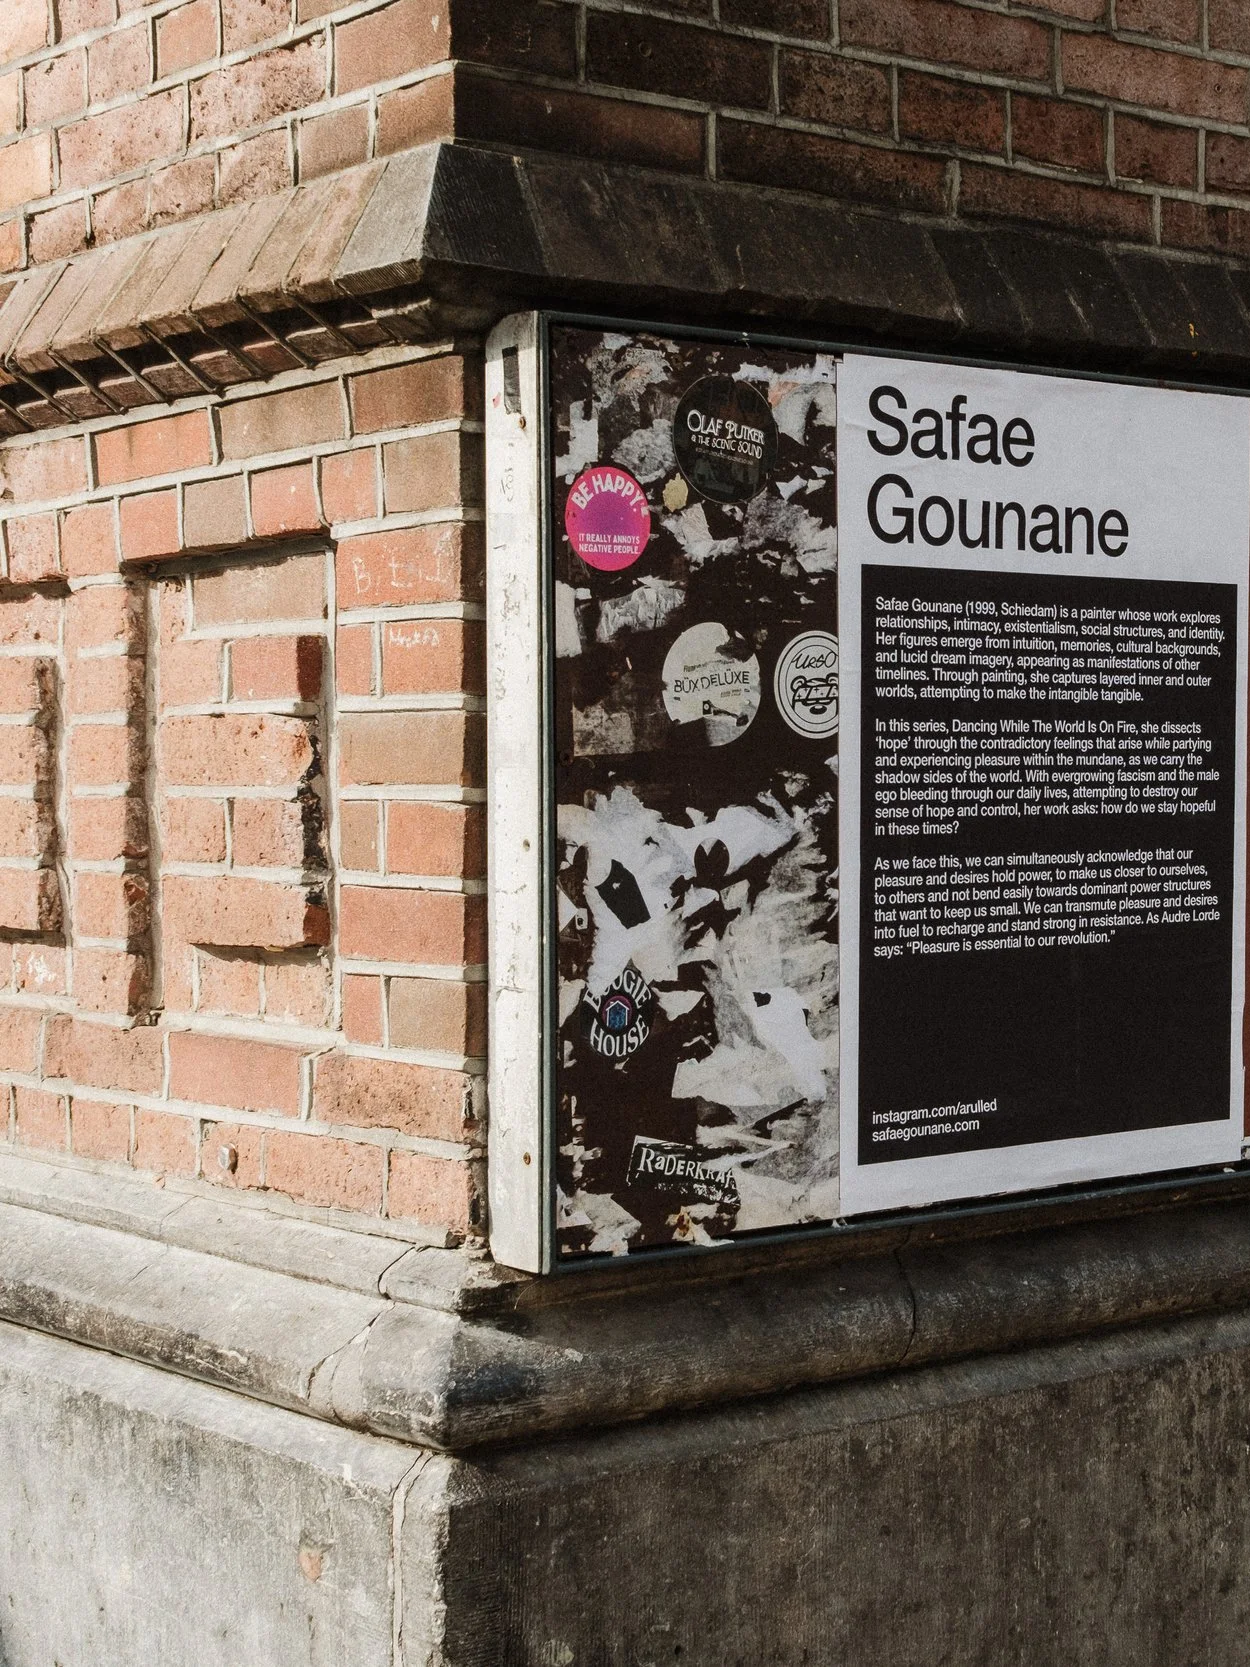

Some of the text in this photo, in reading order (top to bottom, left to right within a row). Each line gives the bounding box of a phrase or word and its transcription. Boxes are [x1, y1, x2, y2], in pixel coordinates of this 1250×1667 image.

[686, 409, 723, 436] OLAF
[866, 385, 1036, 467] Safae
[698, 435, 711, 447] THE
[711, 437, 736, 452] SCENIC
[737, 441, 763, 459] SOUND
[571, 481, 594, 510] BE
[866, 473, 1129, 557] Gounane
[578, 533, 640, 545] IT REALLY ANNOYS
[578, 543, 612, 554] NEGATIVE
[875, 596, 1221, 625] Safae Gounane (1999, Schiedam) is a painter whose work explores
[875, 614, 1225, 642] relationships, intimacy, existentialism, social structures, and identity.
[876, 631, 1221, 657] Her figures emerge from intuition, memories, cultural backgrounds,
[875, 649, 1200, 670] and lucid dream imagery, appearing as manifestations of other
[875, 666, 1211, 687] timelines. Through painting, she captures layered inner and outer
[875, 683, 1144, 704] worlds, attempting to make the intangible tangible.
[913, 735, 957, 752] through
[959, 736, 978, 749] the
[980, 736, 1051, 752] contradictory
[1053, 736, 1093, 752] feelings
[1095, 736, 1116, 749] that
[1118, 736, 1142, 749] arise
[1145, 737, 1170, 749] while
[1172, 737, 1212, 752] partying
[875, 752, 1202, 769] and experiencing pleasure within the mundane, as we carry the
[875, 784, 1198, 804] ego bleeding through our daily lives, attempting to destroy our
[875, 820, 959, 835] in these times?
[874, 848, 1193, 870] As we face this, we can simultaneously acknowledge that our
[874, 862, 1207, 890] pleasure and desires hold power, to make us closer to ourselves,
[874, 879, 1211, 904] to others and not bend easily towards dominant power structures
[873, 945, 903, 959] says:
[962, 938, 972, 951] is
[974, 934, 1021, 950] essential
[1024, 935, 1035, 947] to
[1037, 935, 1056, 946] our
[590, 1014, 650, 1057] HOUSE
[872, 1098, 998, 1125] instagram.com/arulled
[872, 1119, 980, 1142] safaegounane.com
